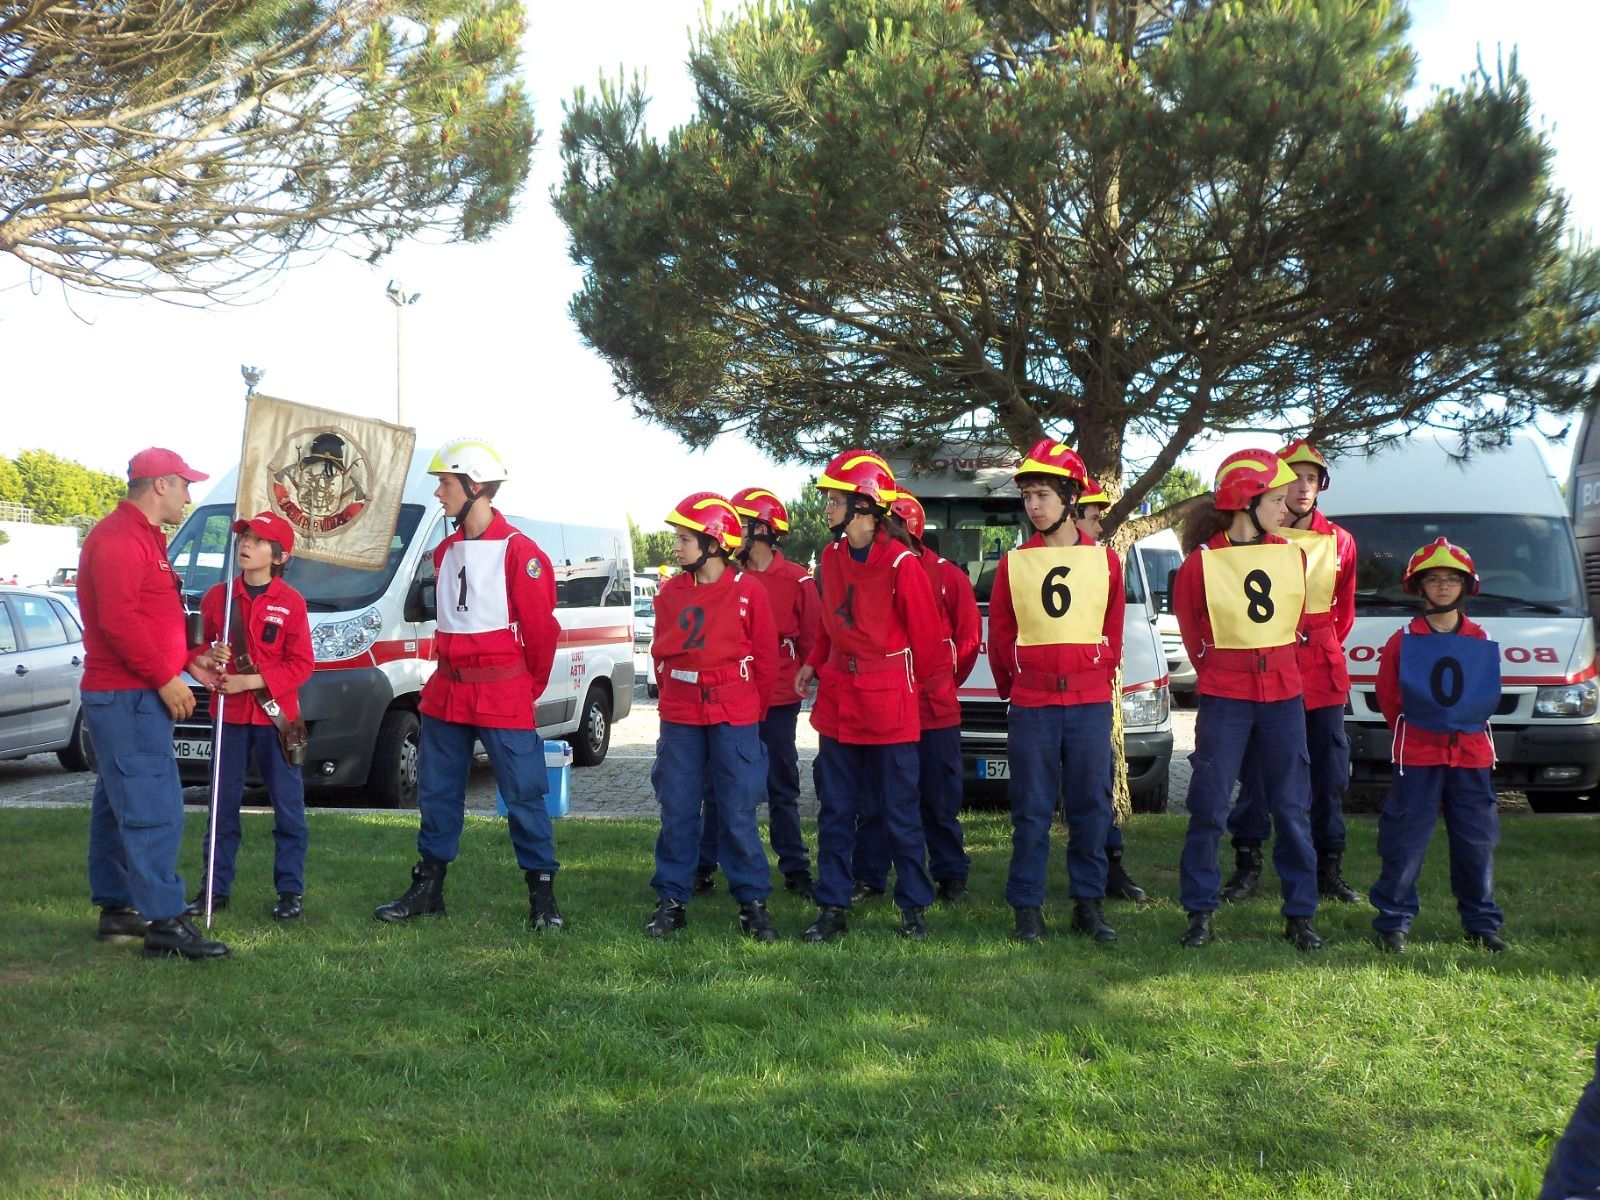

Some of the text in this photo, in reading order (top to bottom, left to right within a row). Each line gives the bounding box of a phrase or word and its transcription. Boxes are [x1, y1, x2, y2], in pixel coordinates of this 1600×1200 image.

[457, 565, 469, 612] 1
[1041, 566, 1072, 619] 6
[1243, 569, 1275, 624] 8
[677, 606, 705, 650] 2
[1430, 656, 1464, 707] 0
